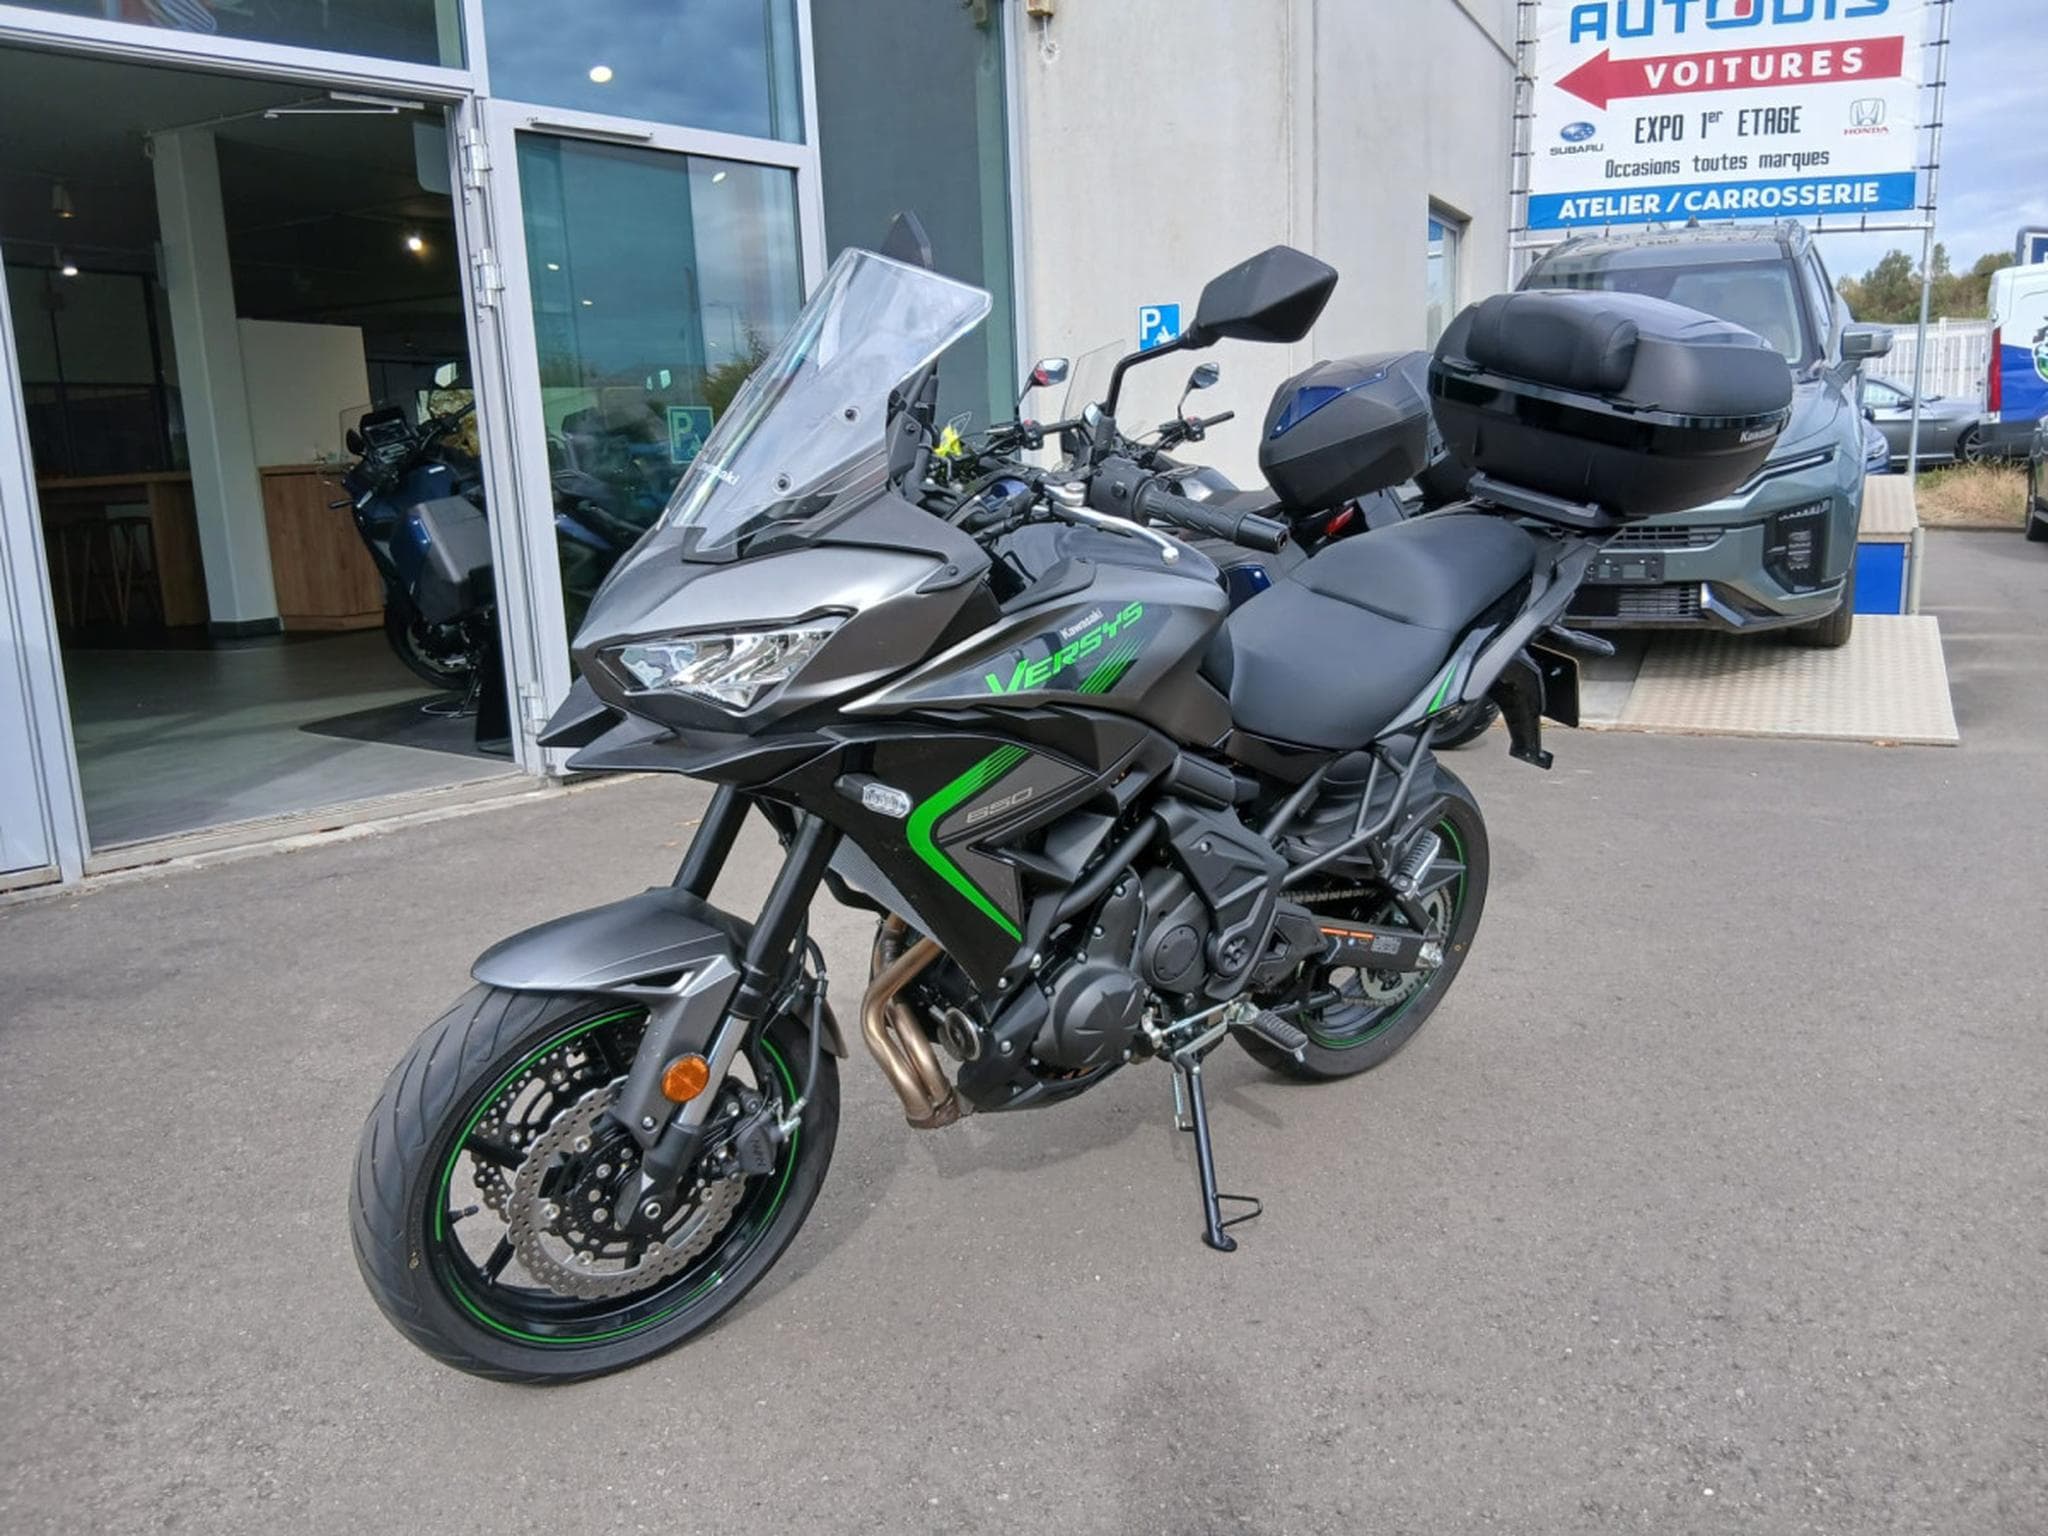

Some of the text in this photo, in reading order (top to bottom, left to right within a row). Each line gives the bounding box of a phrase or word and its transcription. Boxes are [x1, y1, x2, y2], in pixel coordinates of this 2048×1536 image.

[1643, 46, 1865, 90] VOITURES
[1634, 114, 1685, 144] EXPO
[1737, 106, 1803, 137] ETAGE
[1843, 126, 1890, 136] HONDA
[1549, 143, 1604, 156] SUBARU
[1604, 150, 1830, 179] Occasions toutes marques
[1558, 193, 1661, 220] ATELIER
[1141, 307, 1162, 341] P
[1060, 607, 1105, 640] Kawasaki
[985, 599, 1145, 695] VERSYS
[966, 786, 1033, 824] 650
